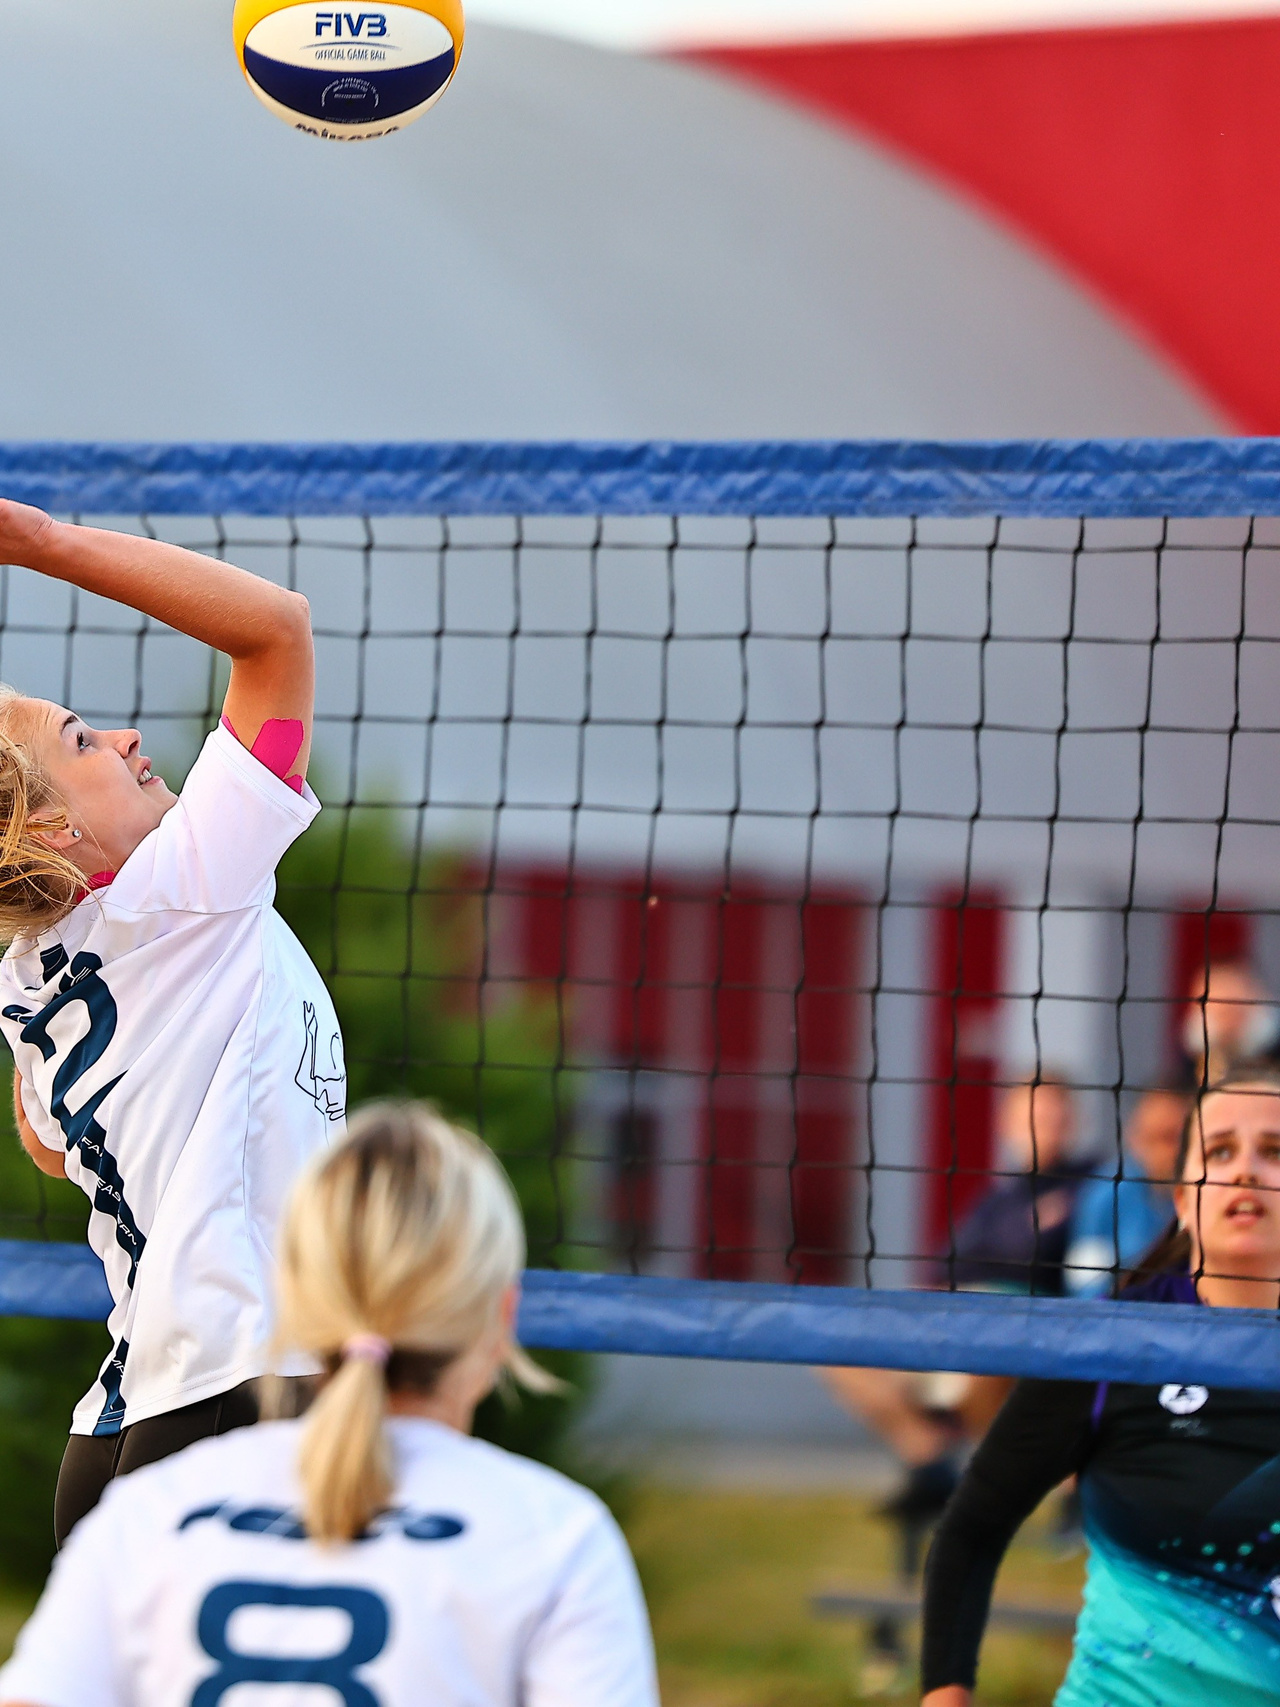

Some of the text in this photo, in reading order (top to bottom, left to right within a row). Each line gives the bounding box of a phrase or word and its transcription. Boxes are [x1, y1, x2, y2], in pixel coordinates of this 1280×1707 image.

[315, 12, 387, 37] FIVB
[315, 48, 386, 61] OFFICIAL GAME BALL
[20, 970, 128, 1152] 2
[81, 1136, 104, 1158] FA
[190, 1580, 388, 1707] 8
